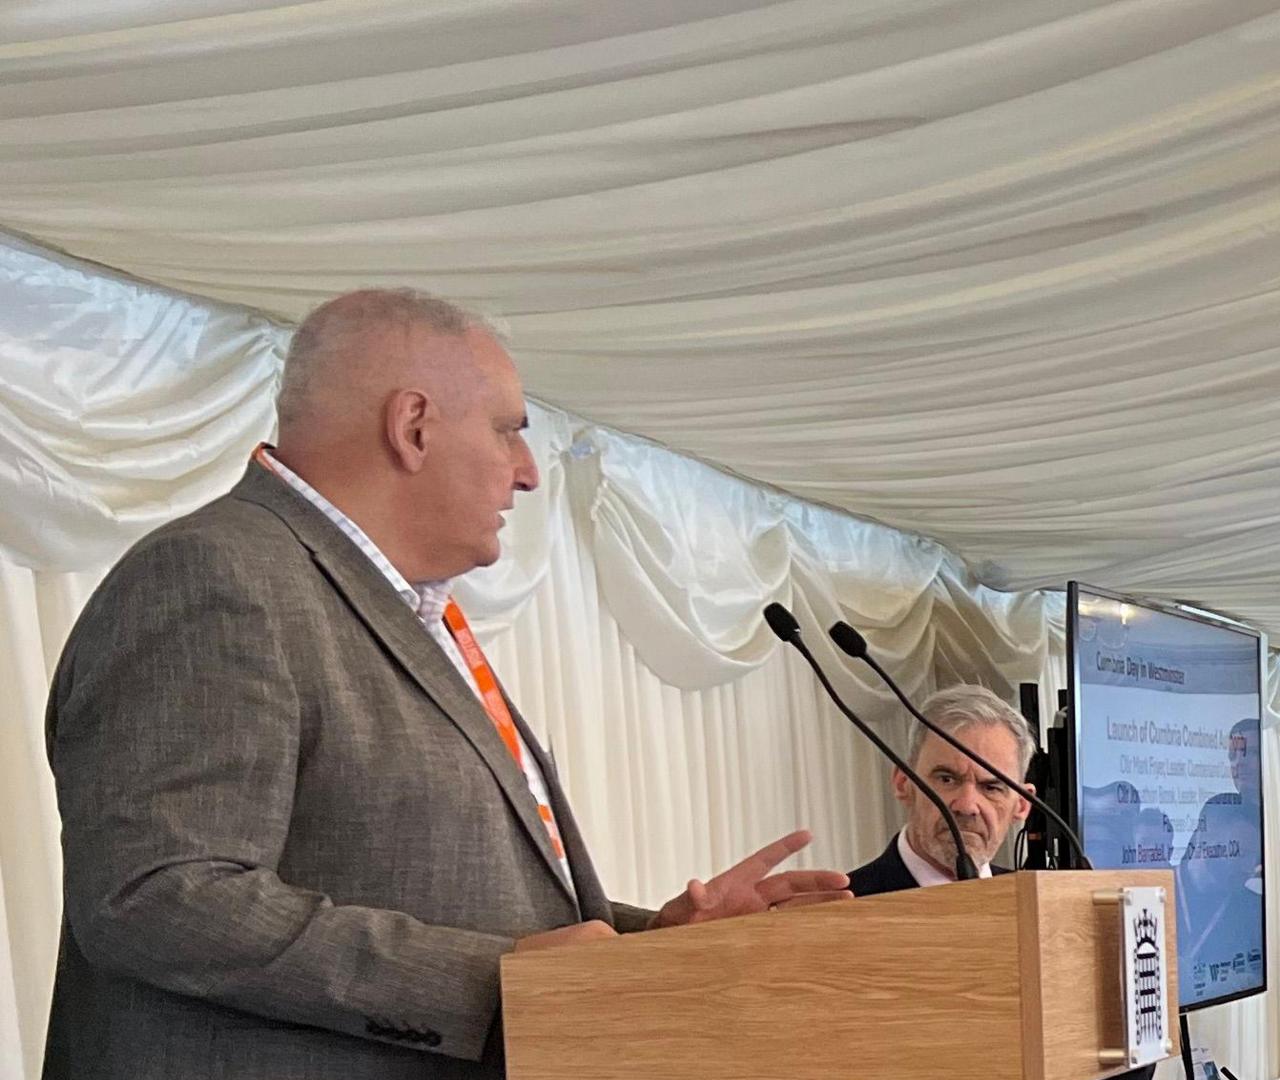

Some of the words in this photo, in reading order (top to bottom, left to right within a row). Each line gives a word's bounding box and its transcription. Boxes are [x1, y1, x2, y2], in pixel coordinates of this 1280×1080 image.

[1127, 656, 1139, 681] Day
[1107, 715, 1138, 742] Launch
[1140, 720, 1148, 743] of
[1149, 721, 1181, 746] Cumbria
[1183, 725, 1218, 749] Combined
